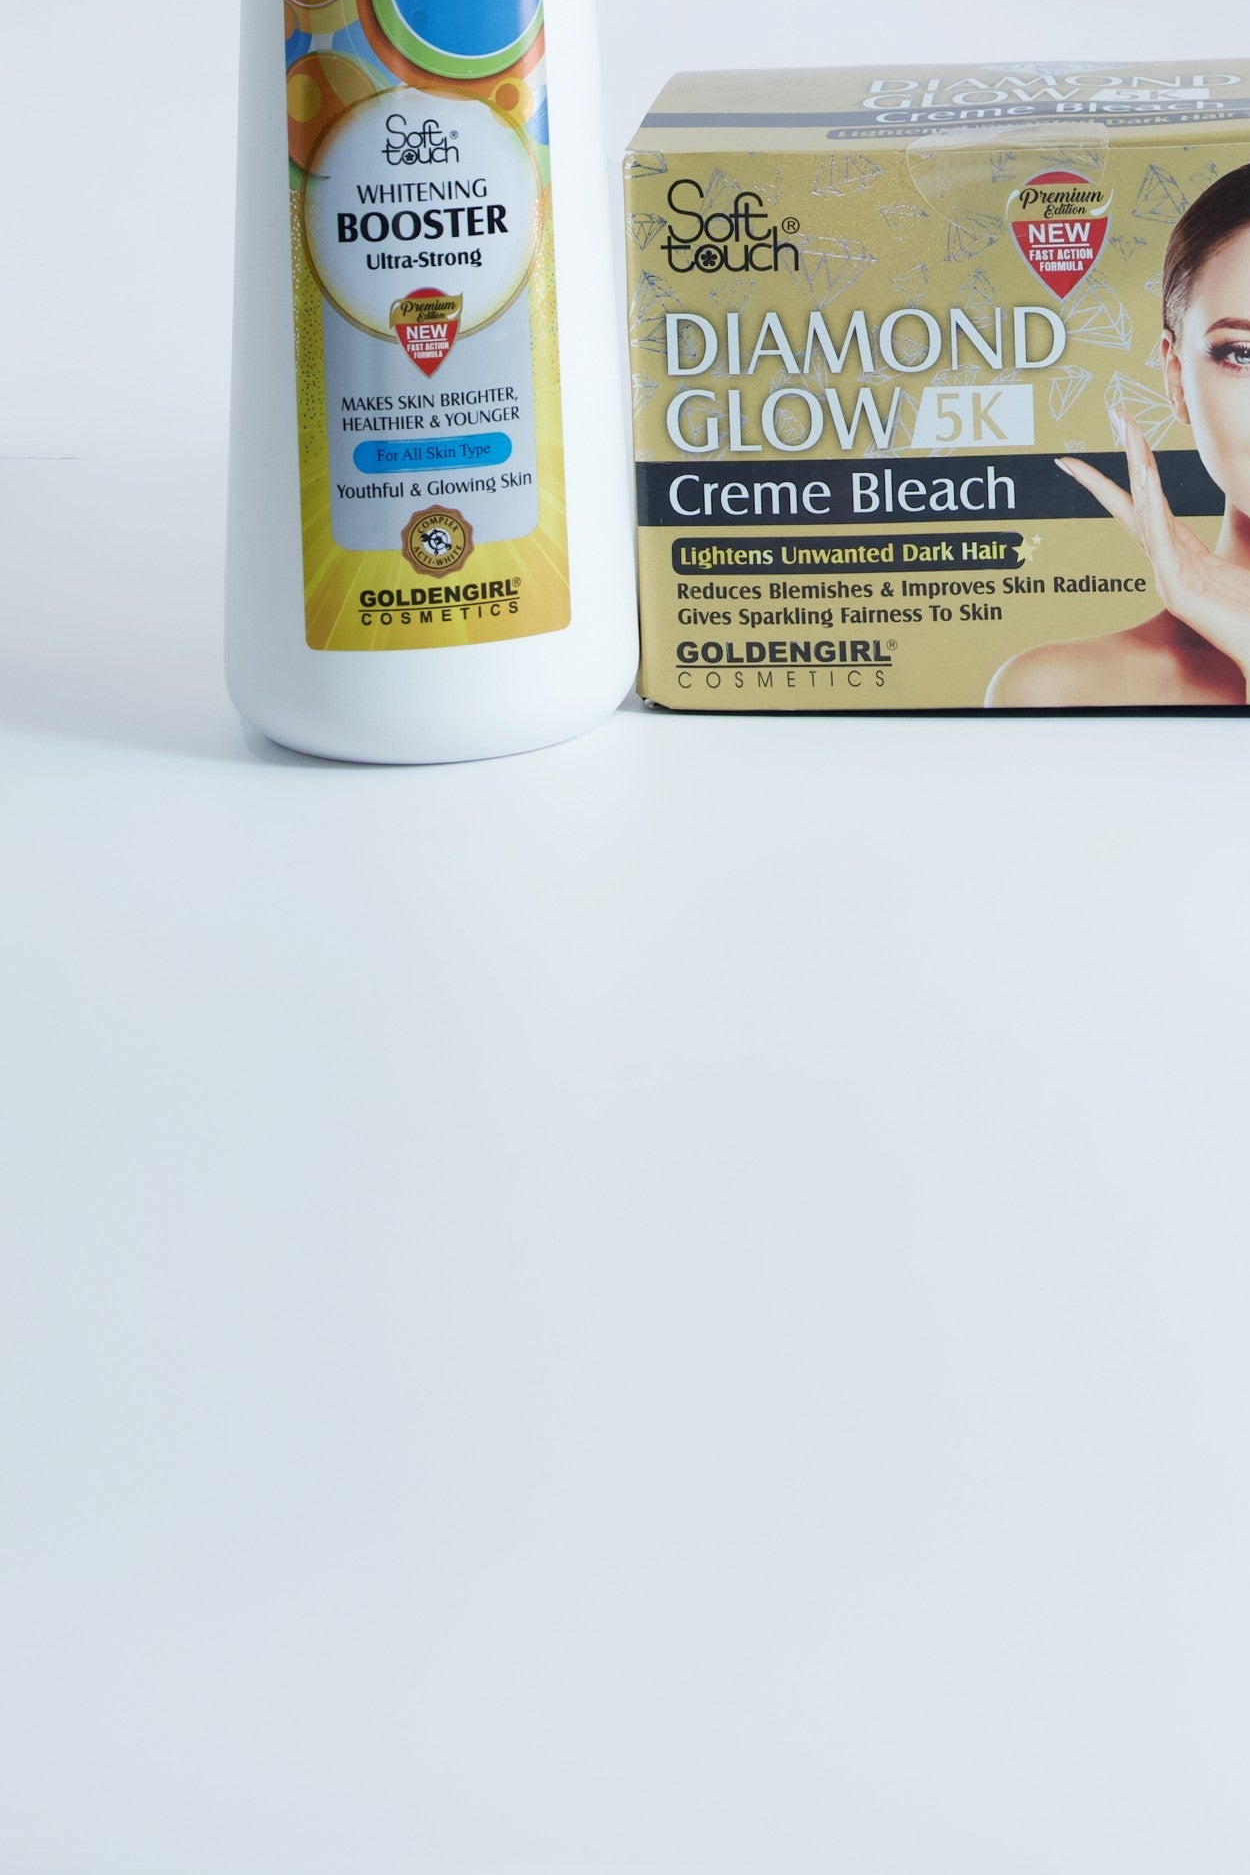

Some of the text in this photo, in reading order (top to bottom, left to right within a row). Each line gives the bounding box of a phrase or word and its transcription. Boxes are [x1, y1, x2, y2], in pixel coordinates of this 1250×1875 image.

[869, 75, 1242, 93] DIAMOND
[862, 88, 1184, 110] GLOW 5K
[876, 105, 1034, 124] Creme
[1056, 101, 1224, 113] Bleach
[1106, 116, 1170, 126] Dark
[1181, 111, 1234, 121] Hair
[385, 114, 442, 149] Soft
[381, 134, 459, 166] touch
[356, 178, 488, 205] WHITENING
[1019, 187, 1104, 210] Premium
[667, 179, 772, 244] Soft
[1043, 203, 1087, 219] Edition
[337, 204, 508, 243] BOOSTER
[1028, 222, 1091, 243] NEW
[366, 247, 483, 271] Ultra-Strong
[660, 227, 800, 274] touch
[1029, 248, 1093, 261] FAST ACTION
[1040, 261, 1084, 272] FORMULA
[400, 300, 456, 316] Premium
[417, 311, 445, 323] Edition
[406, 324, 448, 340] NEW
[666, 306, 1067, 376] DIAMOND
[407, 342, 450, 352] FAST ACTION
[414, 350, 443, 359] FORMULA
[341, 386, 518, 411] MAKES SKIN BRIGHTER,
[342, 406, 520, 432] HEALTHIER & YOUNGER
[666, 386, 1009, 453] GLOW 5K
[377, 443, 491, 462] For All Skin Type
[337, 472, 532, 499] Youthful & Glowing Skin
[668, 465, 1016, 517] Creme Bleach
[418, 516, 459, 533] COMPLEX
[412, 544, 462, 566] ACTI-WHITE
[680, 541, 1007, 570] Lightens Unwanted Dark Hair
[677, 574, 1146, 601] Reduces Blemishes & Improves Skin Radiance
[361, 601, 519, 626] COSMETICS
[677, 603, 1003, 629] Gives Sparkling Fairness To Skin
[677, 670, 886, 689] COSMETICS
